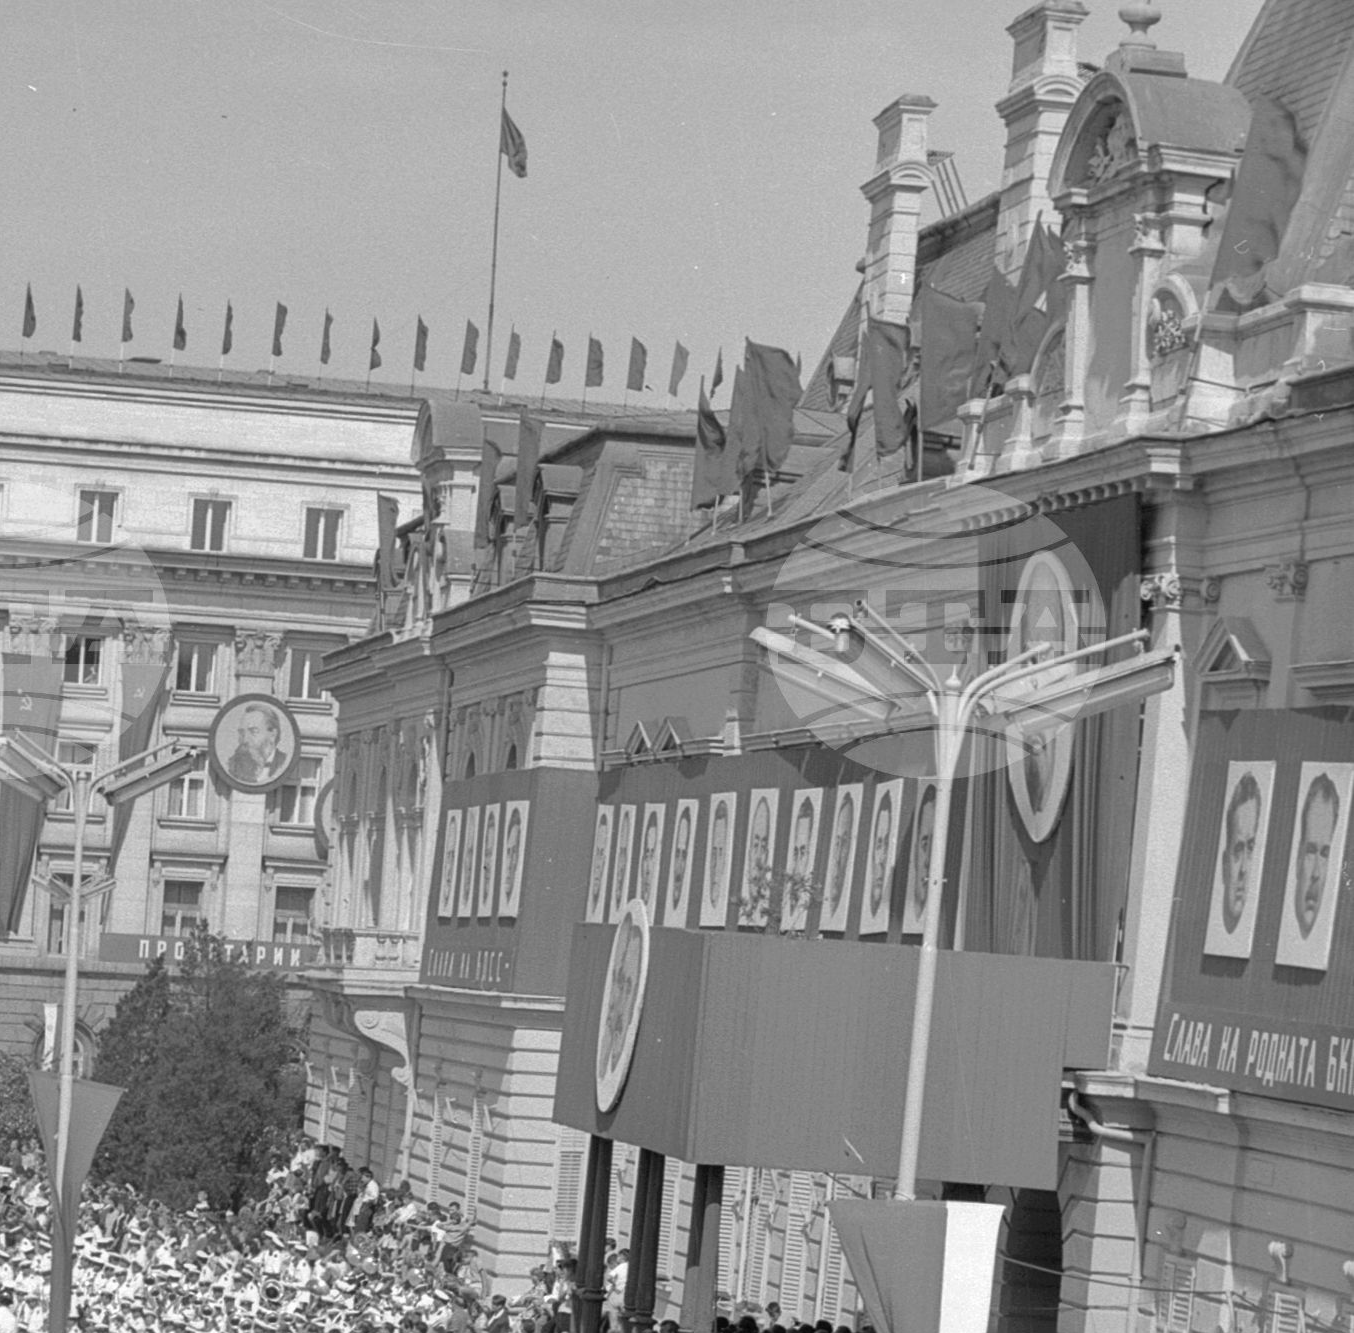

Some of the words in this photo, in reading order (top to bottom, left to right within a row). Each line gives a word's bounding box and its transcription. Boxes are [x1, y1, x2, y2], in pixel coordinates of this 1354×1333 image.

[139, 939, 301, 967] ПРОТАРИИ
[1163, 1012, 1213, 1068] СЛАВА
[1216, 1025, 1241, 1074] НА
[1244, 1029, 1317, 1088] РОДНАТА
[1325, 1035, 1354, 1095] БК
